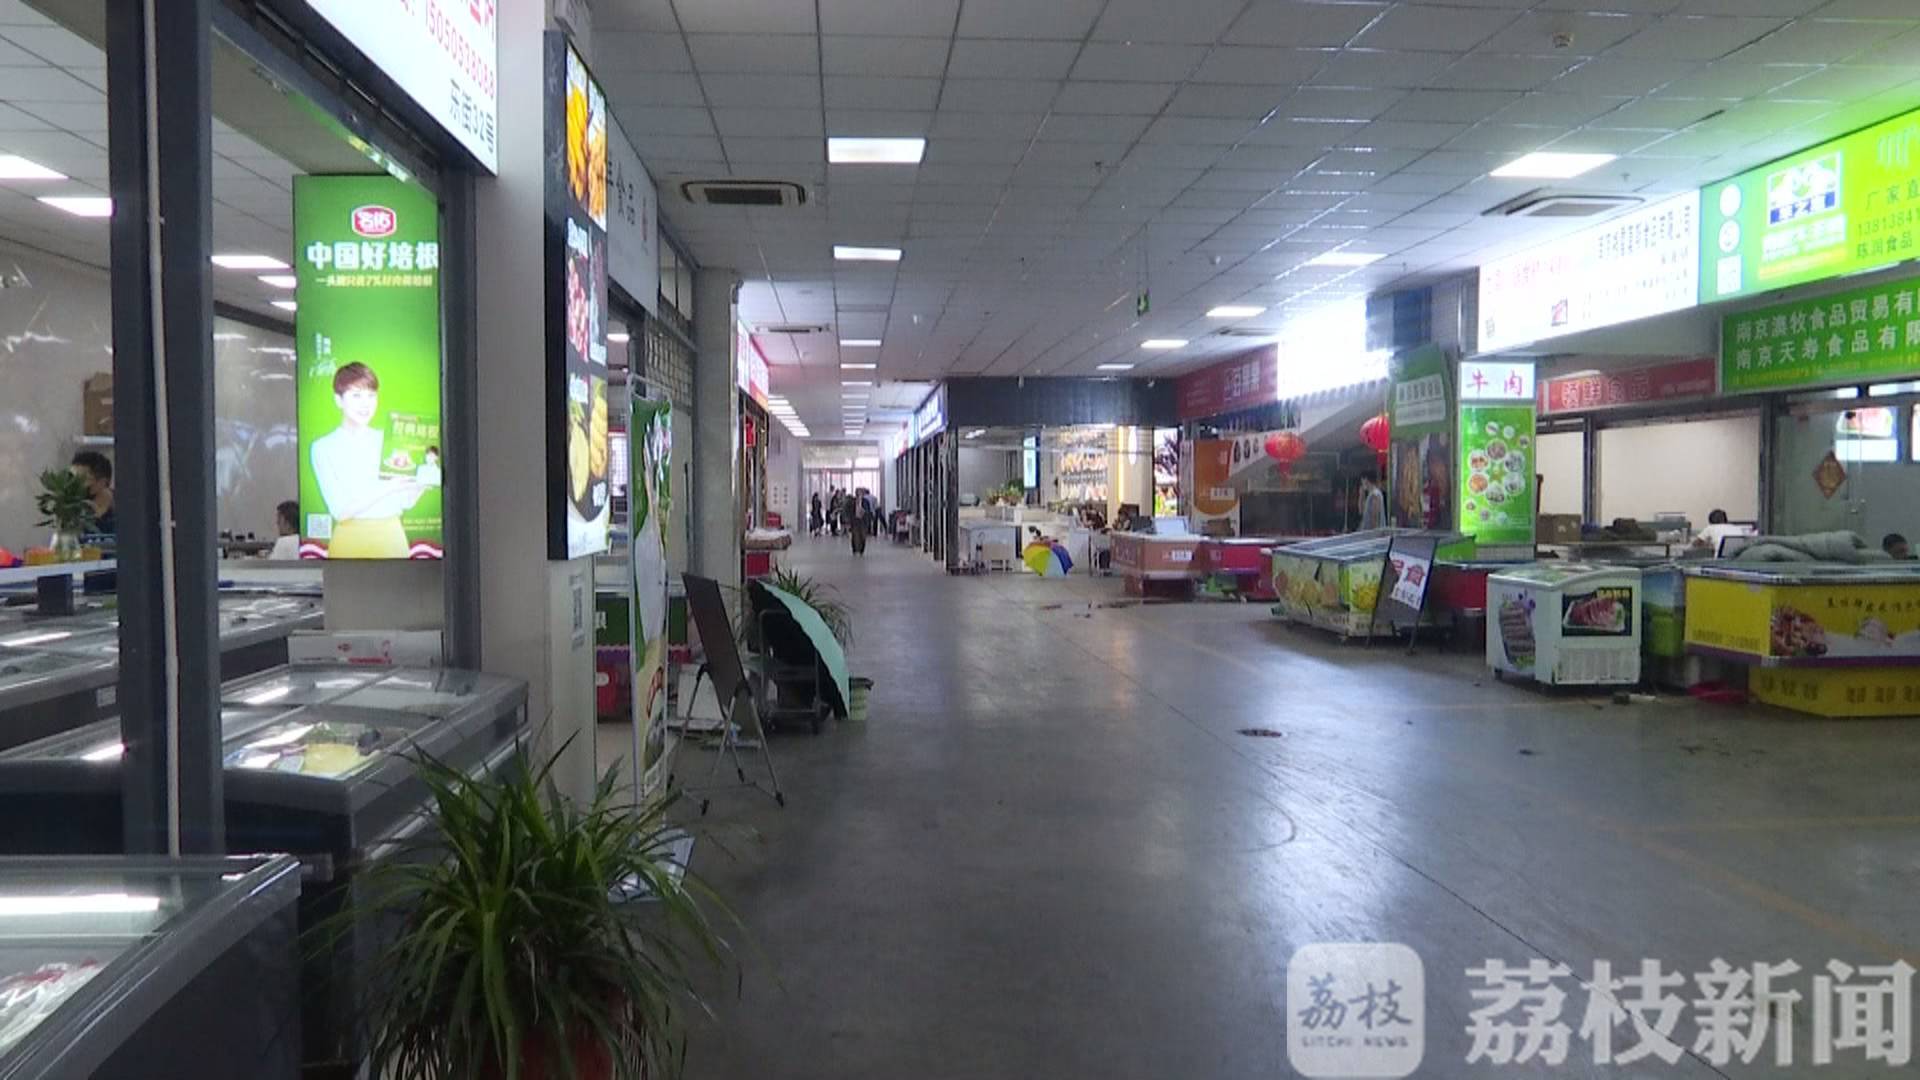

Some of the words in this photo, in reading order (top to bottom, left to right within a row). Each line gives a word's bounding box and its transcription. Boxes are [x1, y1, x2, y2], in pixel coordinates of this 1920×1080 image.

[306, 241, 439, 271] 中国好培根
[1735, 288, 1920, 344] 南京澳牧食品贸易有
[1465, 368, 1524, 398] 牛肉
